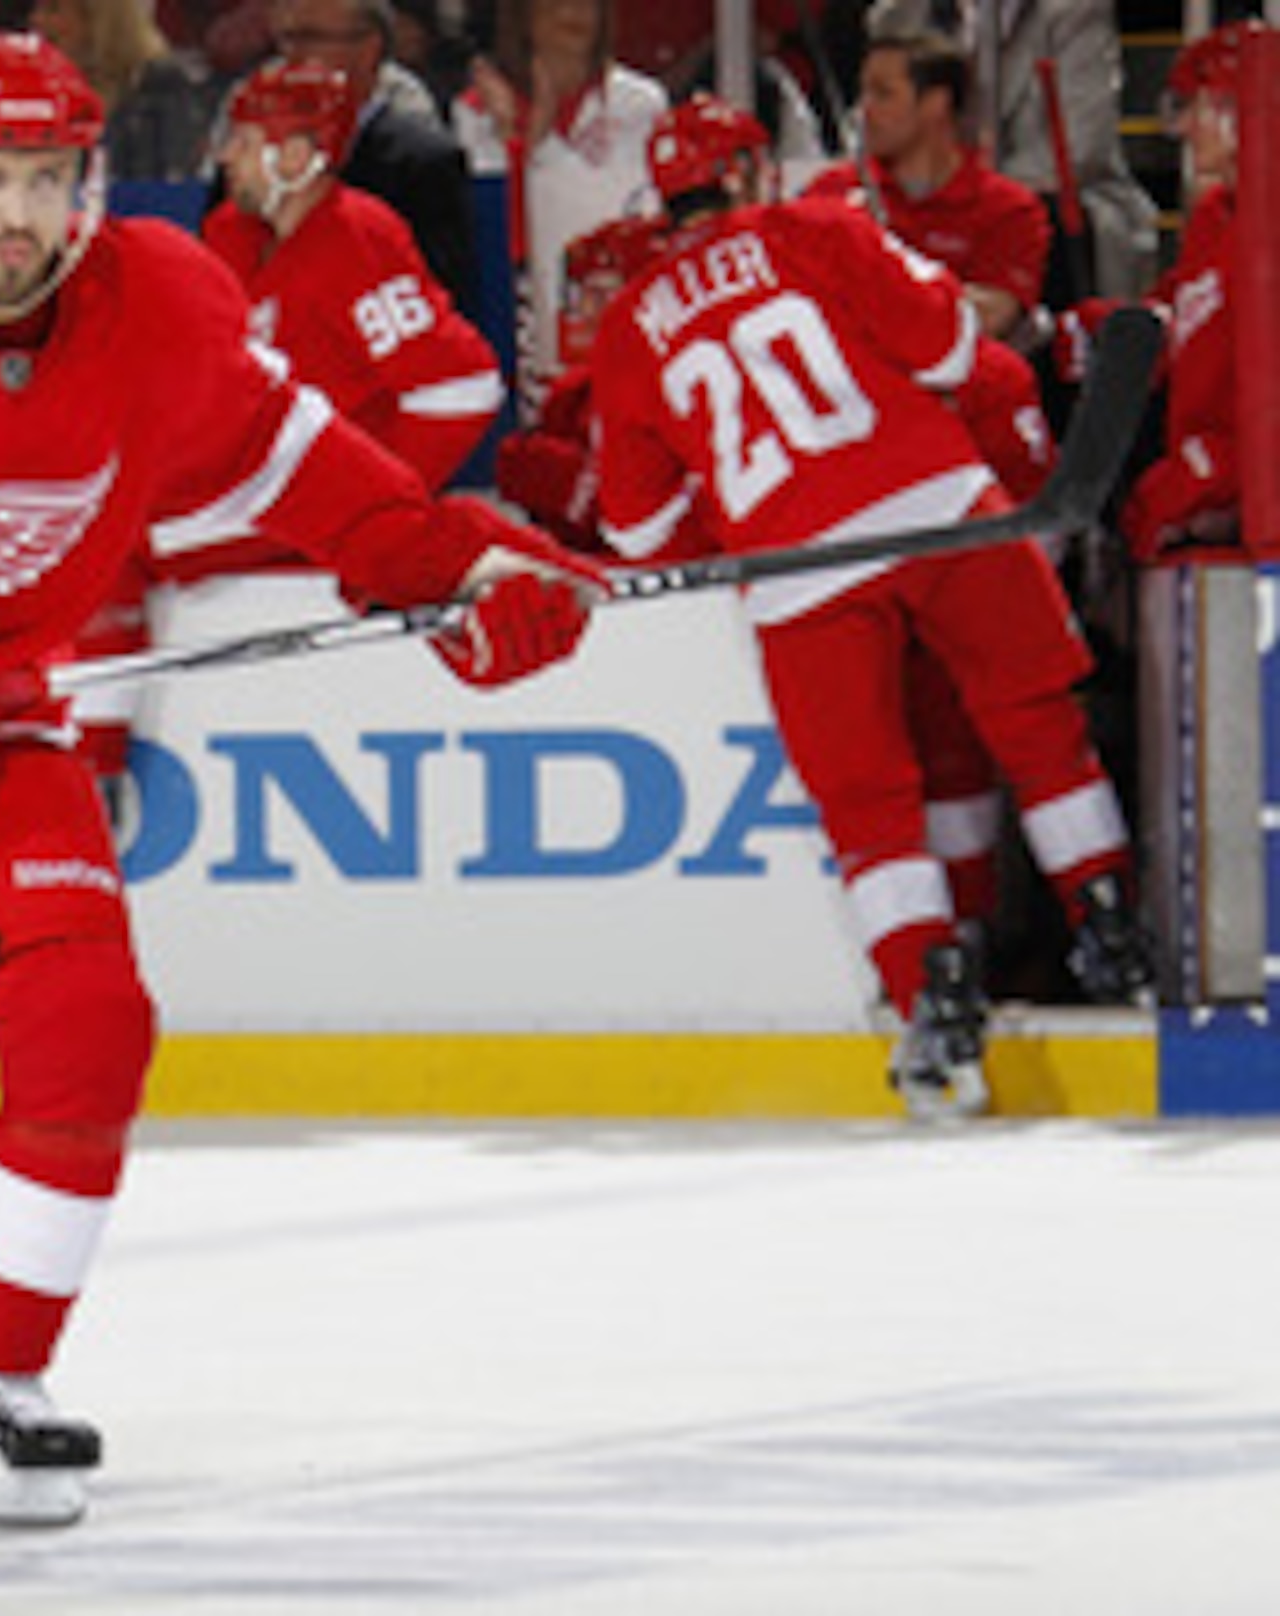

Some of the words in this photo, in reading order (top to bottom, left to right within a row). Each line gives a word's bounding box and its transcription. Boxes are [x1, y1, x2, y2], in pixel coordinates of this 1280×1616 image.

[354, 273, 437, 359] 96
[634, 236, 780, 356] MILLER
[662, 291, 877, 522] 20
[114, 725, 849, 884] ONDA
